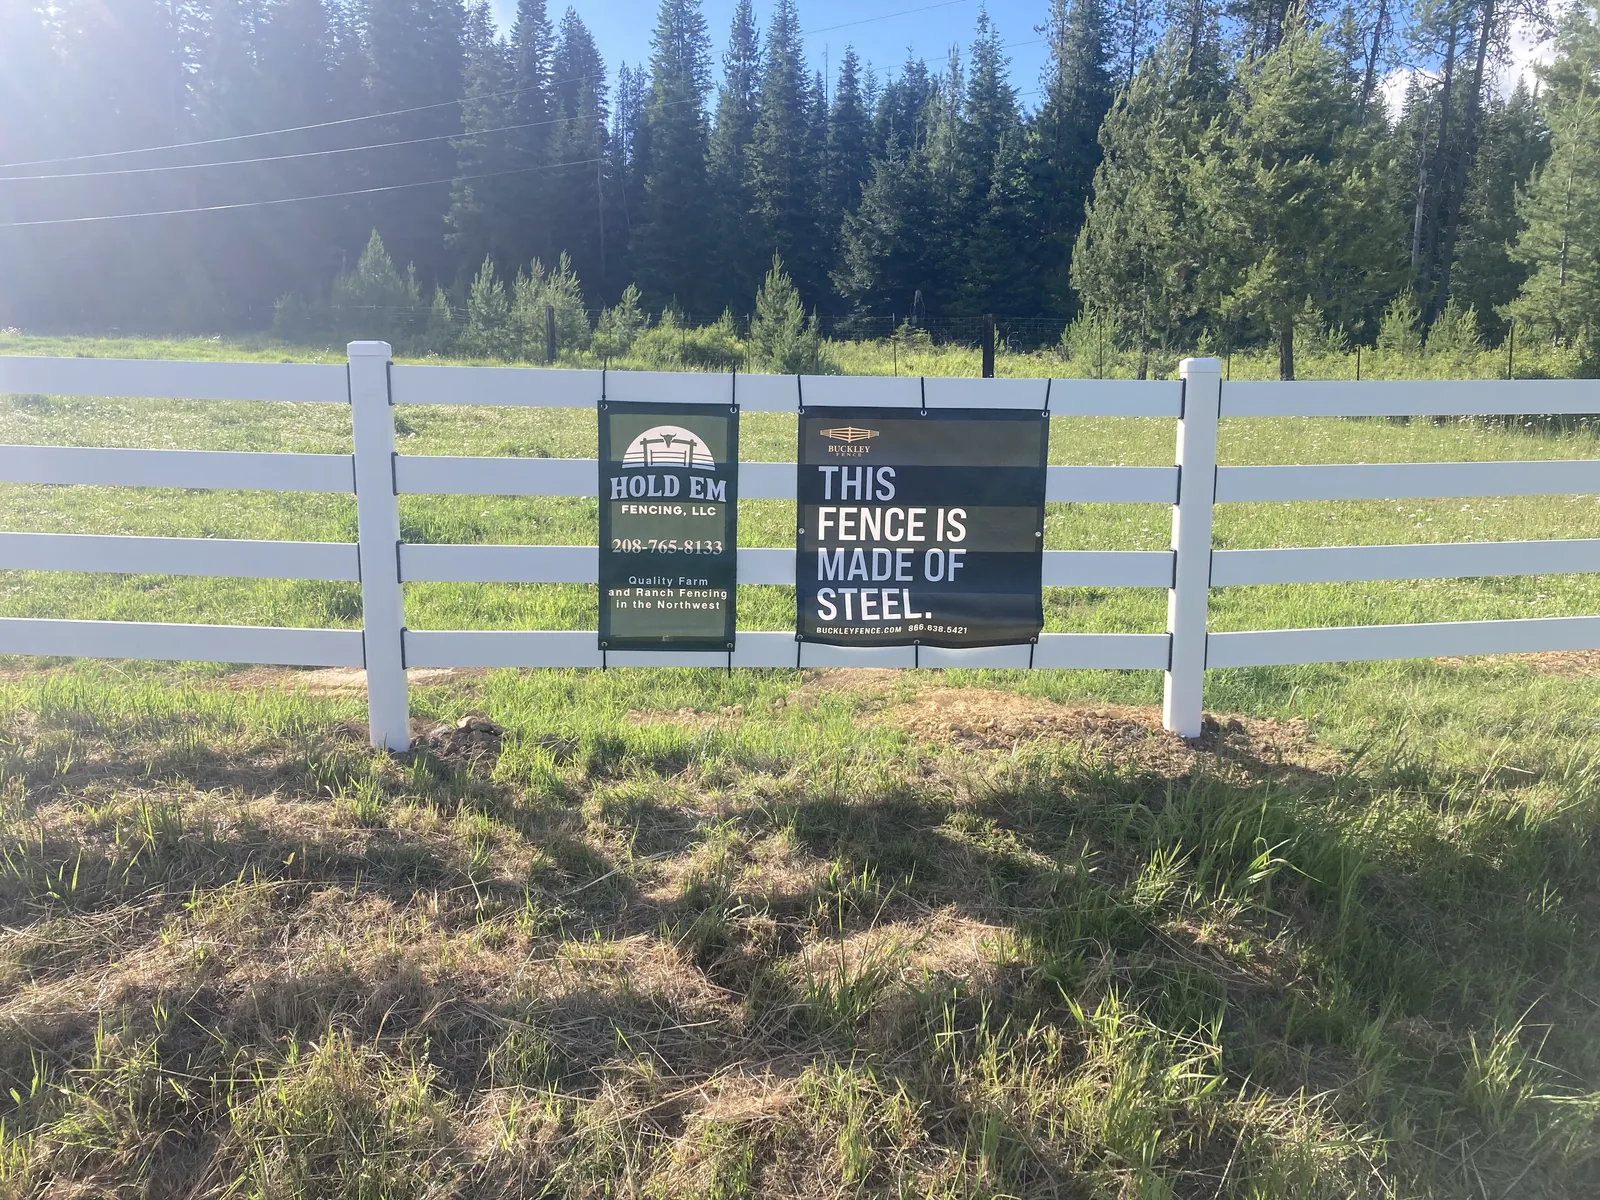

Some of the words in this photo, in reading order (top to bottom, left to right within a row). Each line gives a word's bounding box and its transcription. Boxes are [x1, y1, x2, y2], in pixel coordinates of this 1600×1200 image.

[828, 445, 871, 453] BUCKLEY
[610, 474, 680, 500] HOLD
[689, 476, 727, 503] EM
[818, 466, 896, 501] THIS
[621, 505, 687, 516] FENCING,
[692, 506, 716, 516] LLC
[818, 507, 926, 542] FENCE
[936, 508, 966, 542] IS
[612, 538, 723, 555] 208-765-8133
[817, 548, 914, 581] MADE
[924, 549, 966, 582] OF
[629, 576, 673, 586] Quality
[679, 577, 708, 586] Farm
[608, 589, 630, 597] and
[636, 588, 674, 597] Ranch
[680, 589, 727, 599] Fencing
[617, 600, 627, 608] in
[657, 601, 720, 610] Northwest
[817, 587, 932, 621] STEEL.
[816, 626, 902, 635] BUCKLEYFENCE.COM
[908, 624, 968, 635] 866.638.5421
